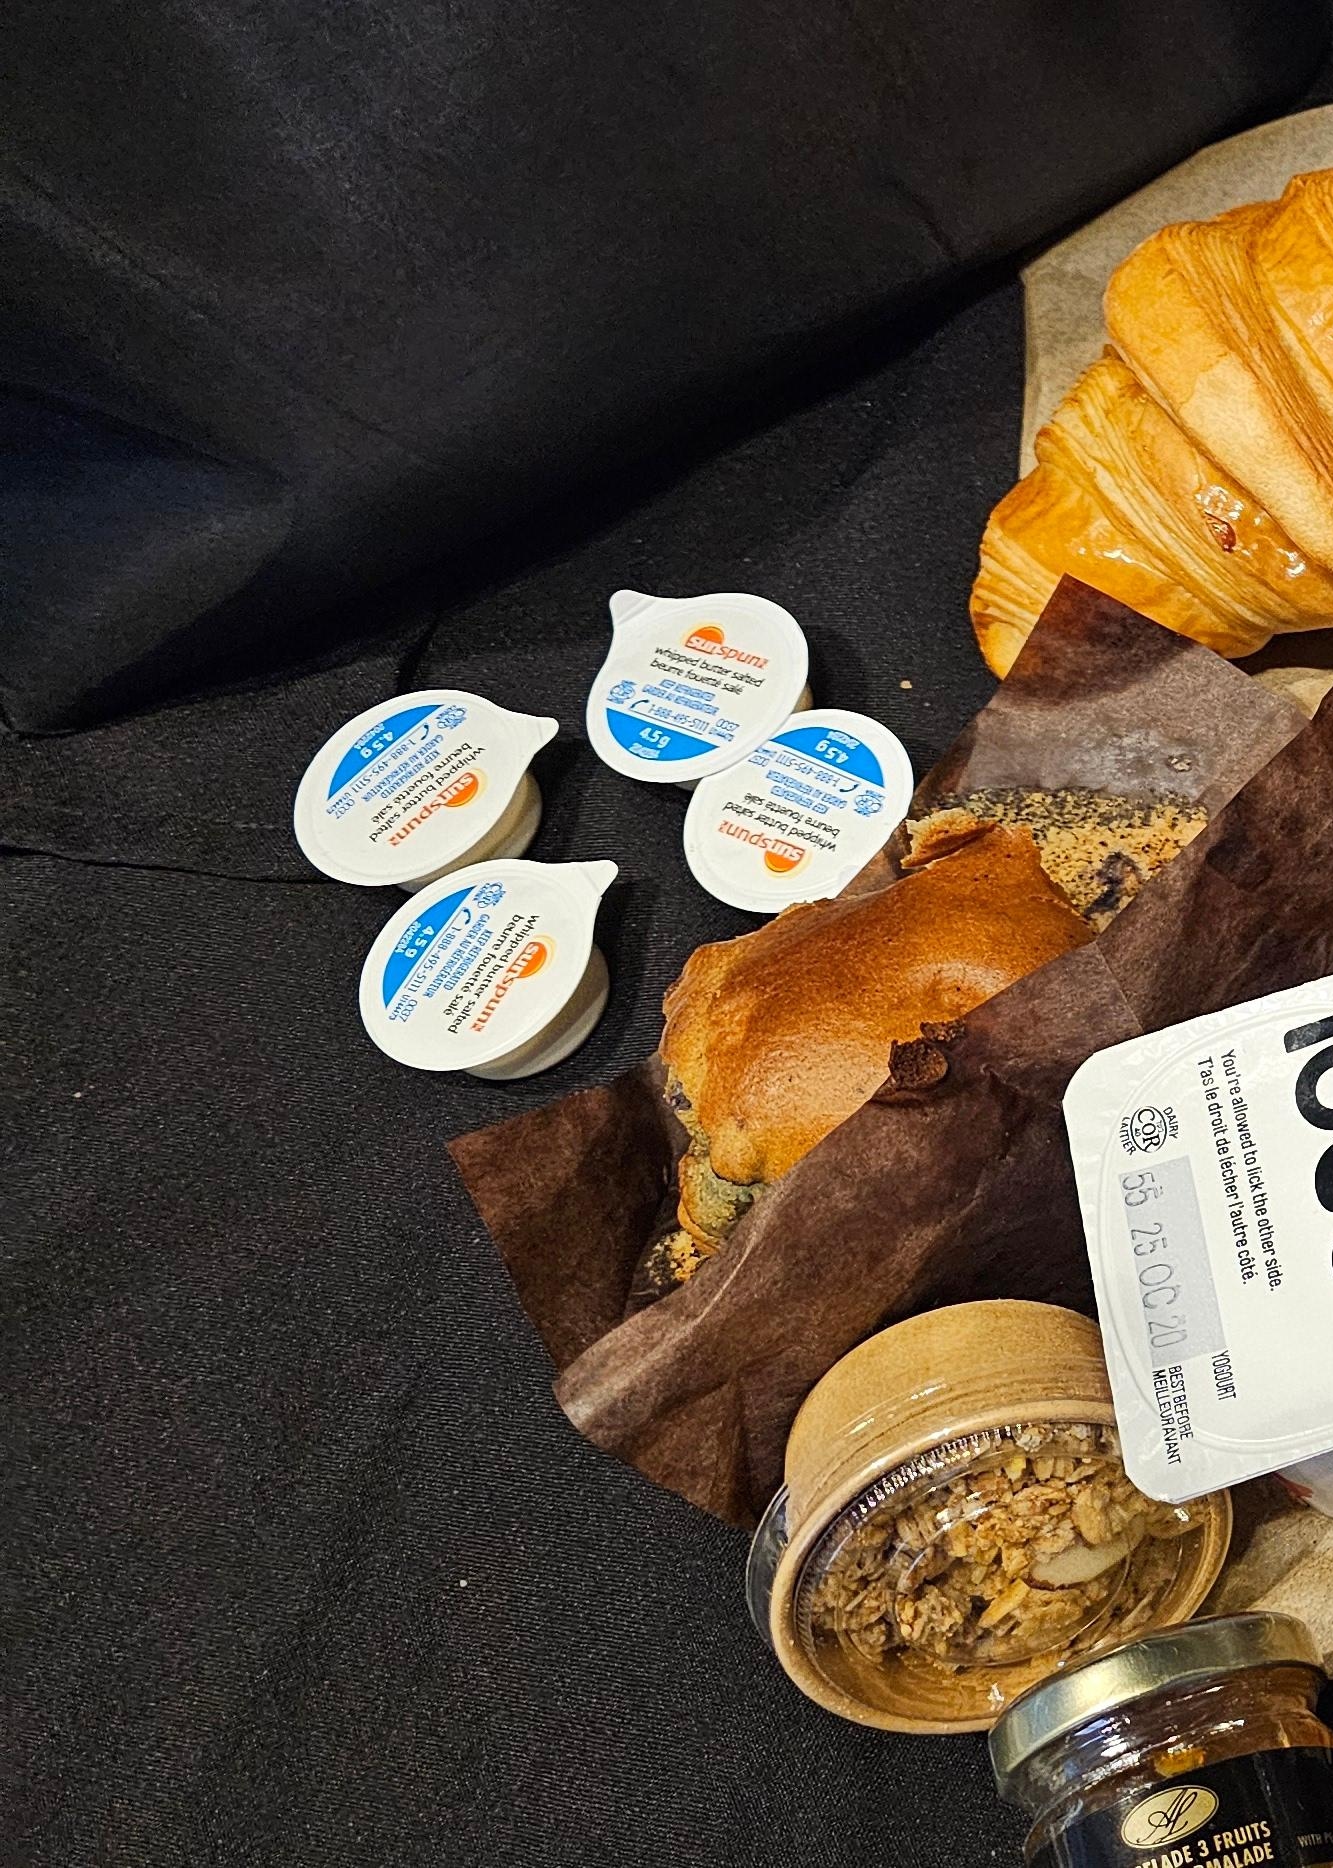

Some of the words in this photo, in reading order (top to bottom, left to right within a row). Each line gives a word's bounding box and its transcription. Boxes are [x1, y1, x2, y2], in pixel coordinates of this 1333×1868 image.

[434, 743, 472, 771] beurre
[436, 748, 484, 786] whipped
[393, 772, 434, 804] fouetté
[402, 785, 437, 813] butter
[369, 812, 400, 842] salted
[371, 804, 393, 824] salé
[477, 929, 493, 946] KEEP
[492, 915, 524, 950] beurre
[499, 916, 539, 962] whipped
[408, 927, 462, 992] 1-888-495-5111
[461, 953, 496, 992] fouetté
[474, 964, 504, 998] butter
[443, 994, 463, 1015] salé
[448, 1000, 475, 1034] salted
[1198, 1056, 1214, 1086] T'as
[1221, 1049, 1241, 1095] You're
[1205, 1087, 1219, 1100] le
[1163, 1107, 1178, 1139] DAIRY
[1208, 1103, 1228, 1137] droit
[1232, 1097, 1256, 1149] allowed
[1216, 1138, 1231, 1155] de
[1244, 1150, 1257, 1165] to
[1119, 1170, 1159, 1208] 55
[1219, 1156, 1239, 1199] lécher
[1247, 1167, 1264, 1192] lick
[1253, 1193, 1268, 1216] the
[1128, 1221, 1168, 1257] 25
[1228, 1201, 1248, 1247] l'autre
[1258, 1219, 1275, 1255] other
[1238, 1250, 1258, 1284] côté.
[1265, 1258, 1283, 1291] side.
[1135, 1261, 1180, 1310] OC
[1145, 1313, 1188, 1349] 20
[1168, 1365, 1185, 1393] BEST
[1212, 1350, 1236, 1400] YOGOURT
[1152, 1370, 1175, 1425] MEILLEUR
[1173, 1394, 1193, 1440] BEFORE
[1162, 1428, 1181, 1464] AVANT
[1197, 1840, 1210, 1857] 3
[1213, 1821, 1272, 1852] FRUITS
